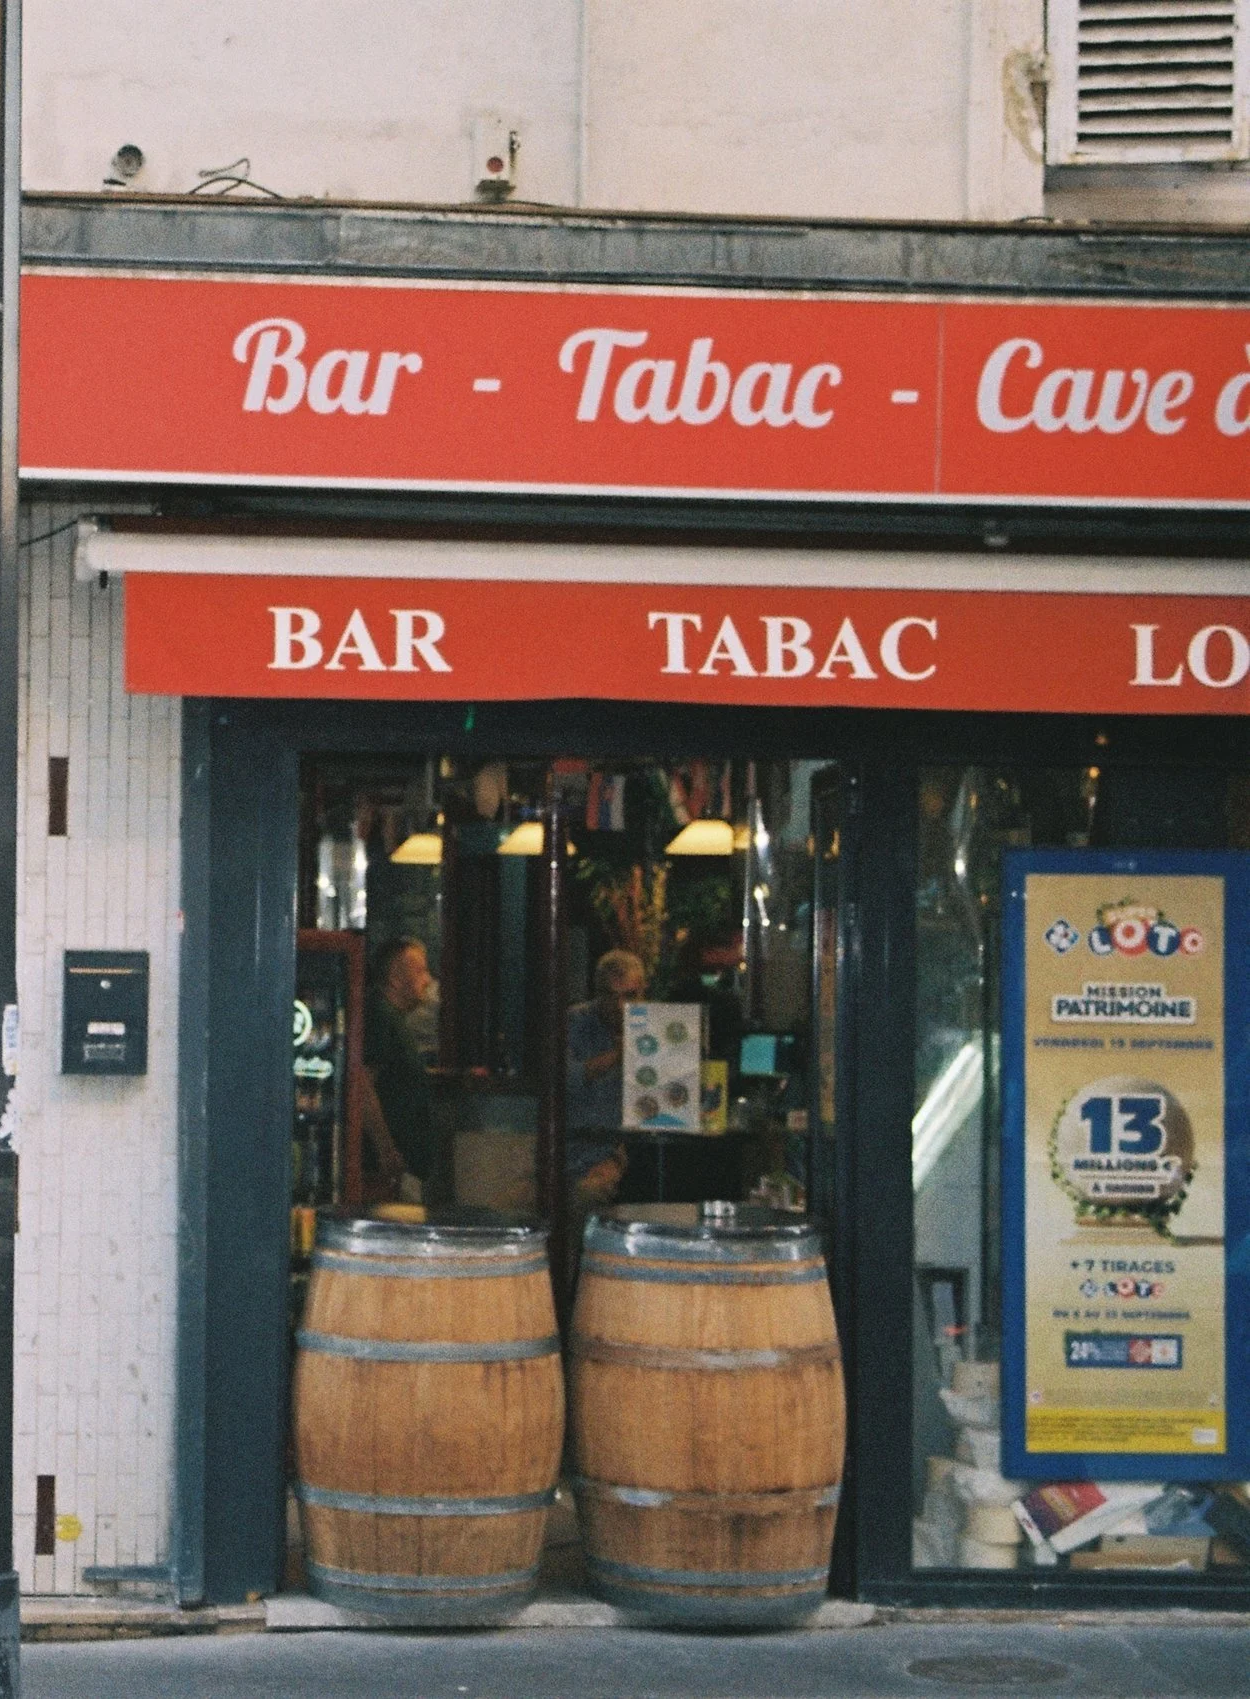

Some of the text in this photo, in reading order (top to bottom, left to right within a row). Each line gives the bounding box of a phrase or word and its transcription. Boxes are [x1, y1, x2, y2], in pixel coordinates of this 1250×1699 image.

[232, 318, 423, 416] Bar
[559, 328, 842, 428] Tabac
[977, 337, 1194, 434] Cave
[268, 607, 453, 673] BAR
[648, 612, 938, 681] TABAC
[1089, 919, 1203, 958] LOTO
[1056, 1000, 1191, 1018] PATRIMOINE
[1087, 986, 1162, 998] MISSION
[1081, 1096, 1163, 1155] 13
